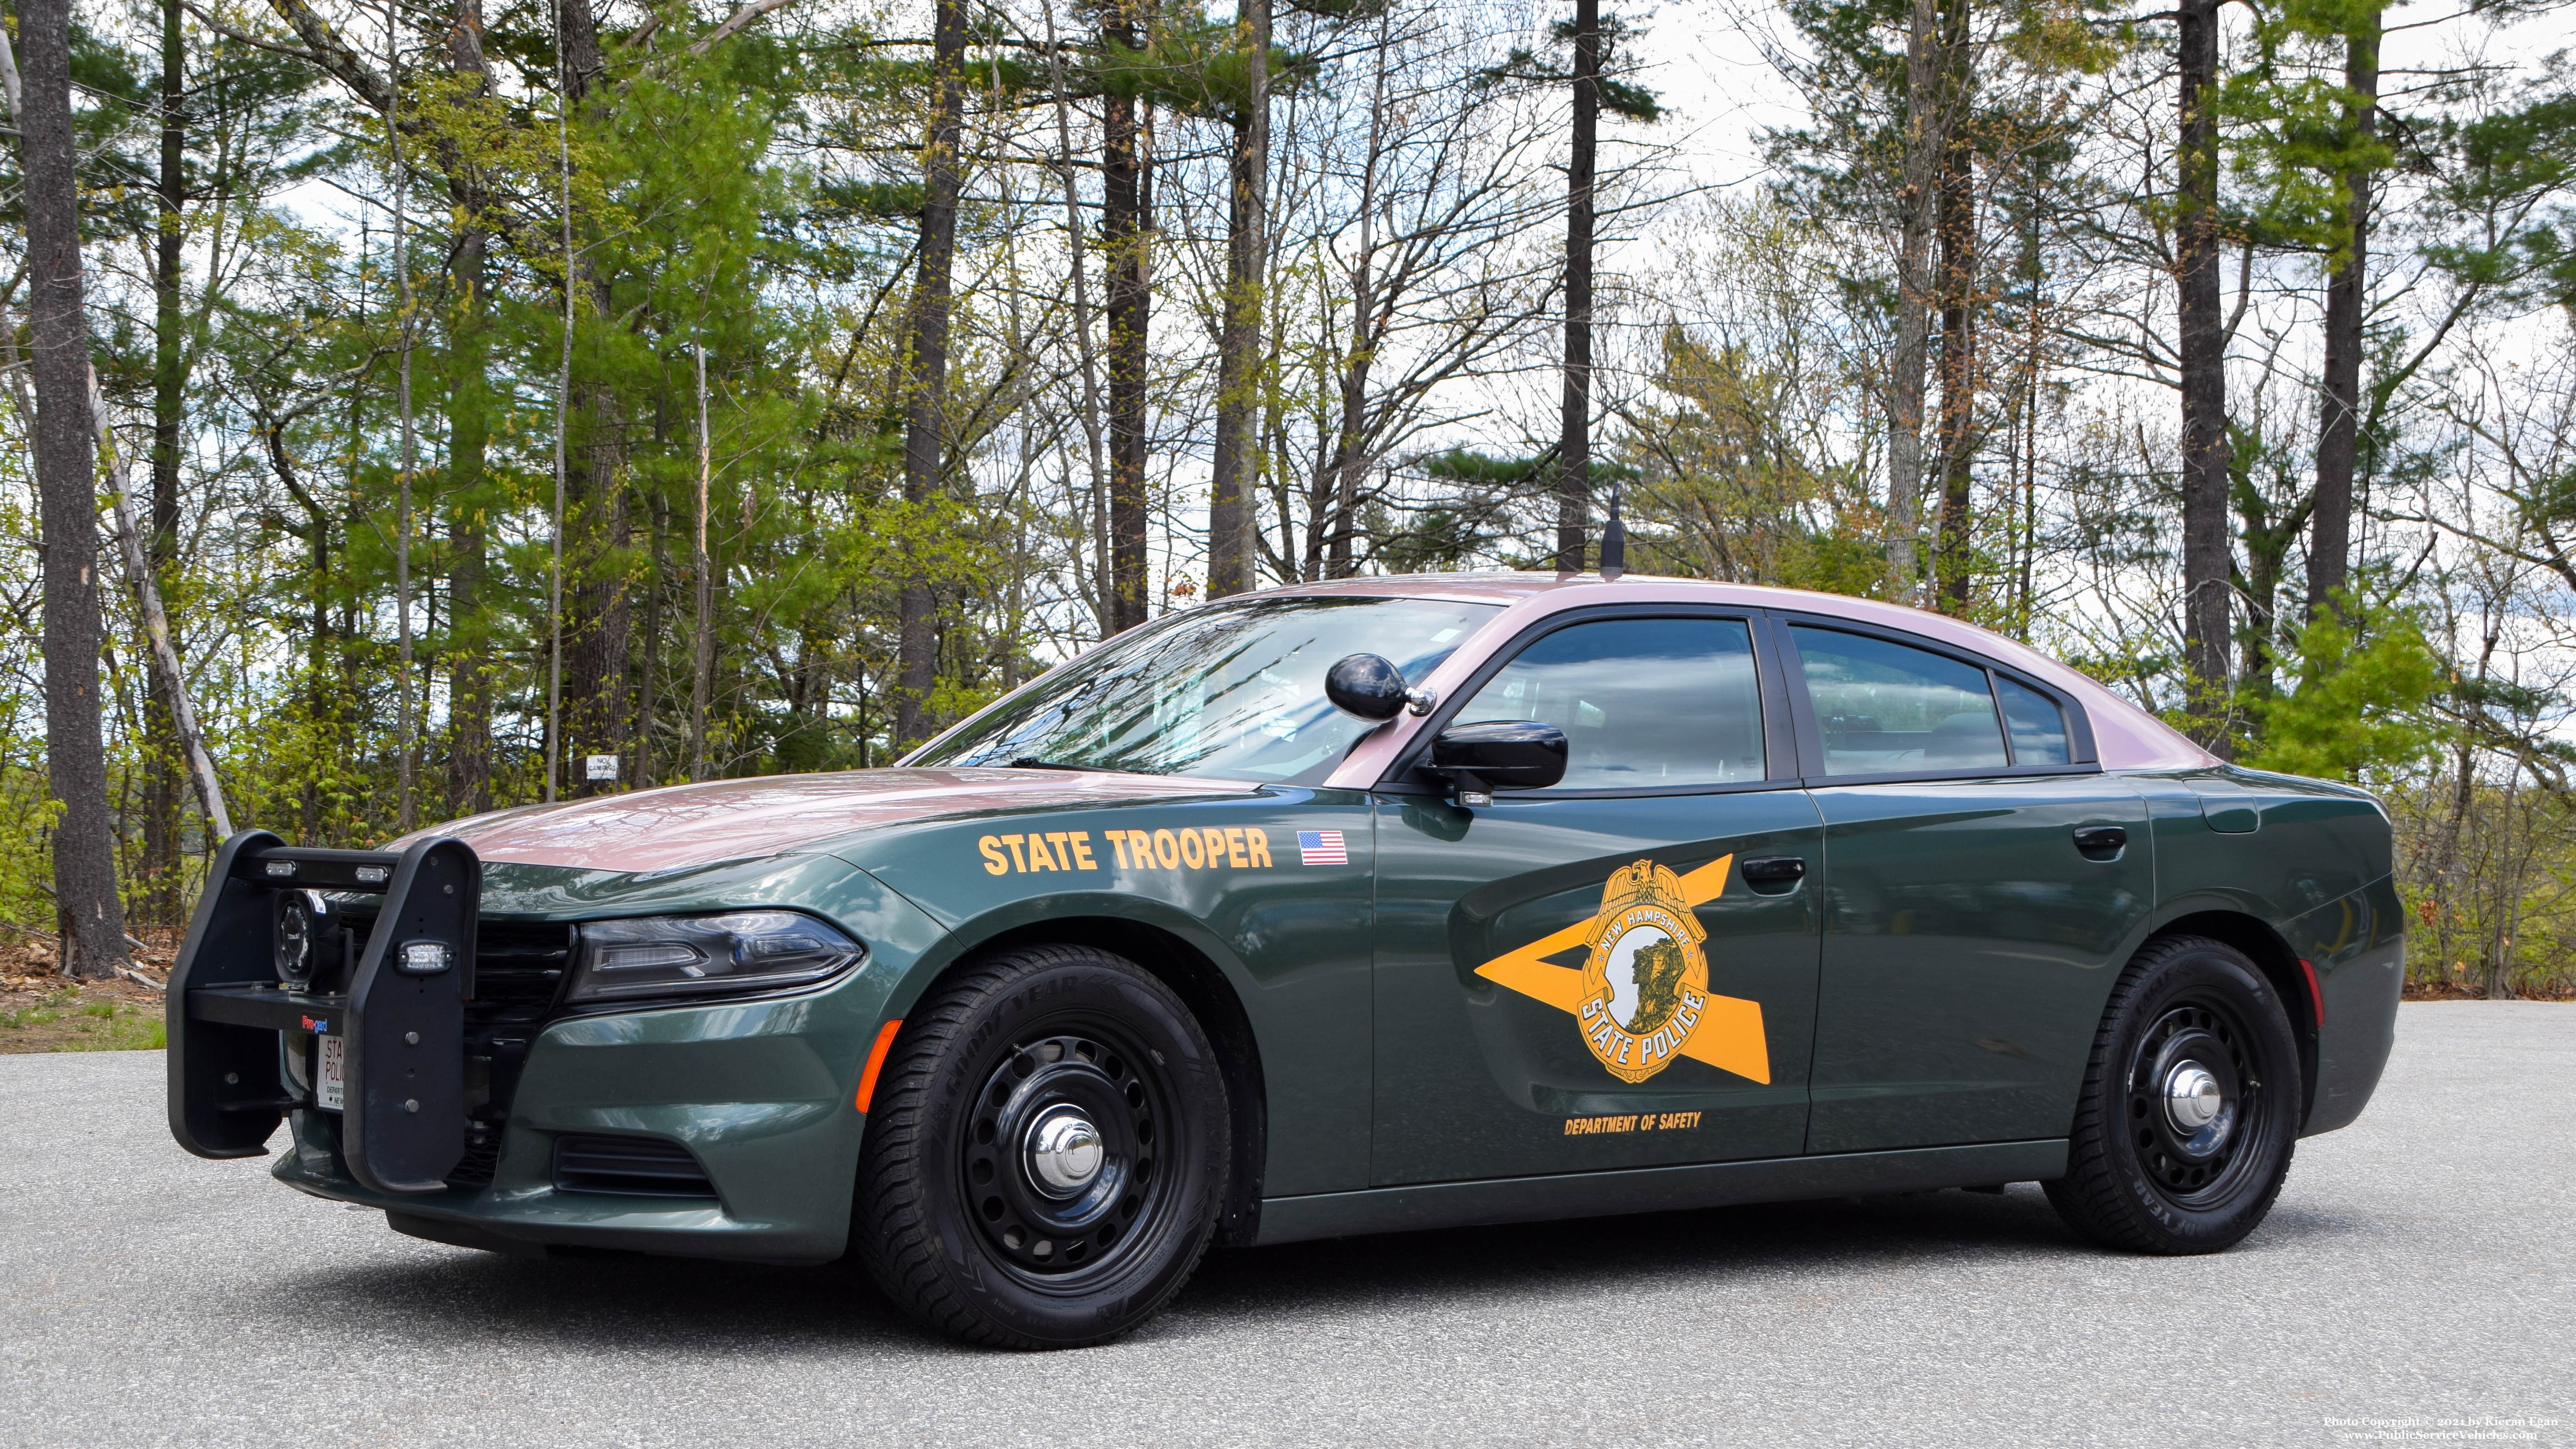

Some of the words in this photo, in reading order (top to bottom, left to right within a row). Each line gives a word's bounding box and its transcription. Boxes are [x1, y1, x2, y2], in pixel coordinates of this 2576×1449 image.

[978, 831, 1098, 876] STATE
[1104, 828, 1273, 870] TROOPER
[1601, 919, 1623, 952] NEW
[1627, 909, 1690, 949] HAMPSHIRE
[1582, 996, 1634, 1065] STATE
[1641, 990, 1706, 1065] POLICE
[327, 1086, 344, 1095] DEPART
[1564, 1115, 1638, 1135] DEPARTMENT
[1641, 1114, 1656, 1131] OF
[1659, 1112, 1702, 1130] SAFETY
